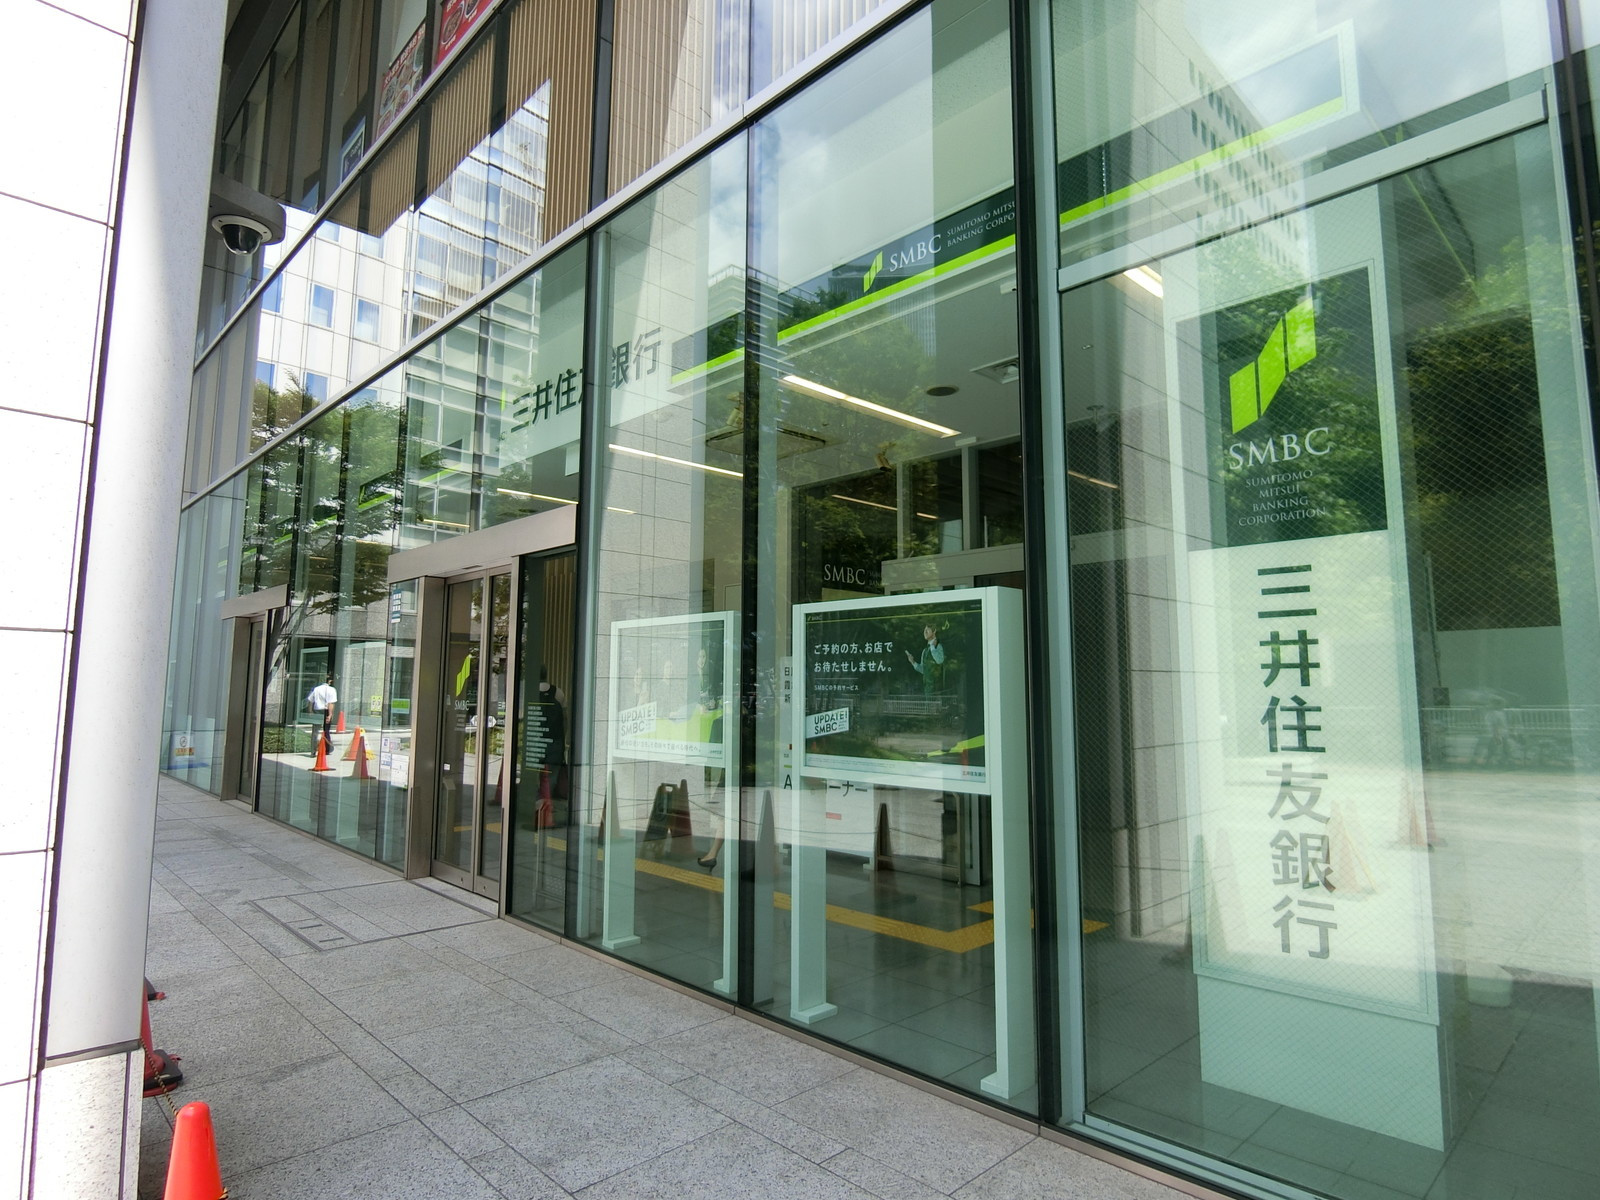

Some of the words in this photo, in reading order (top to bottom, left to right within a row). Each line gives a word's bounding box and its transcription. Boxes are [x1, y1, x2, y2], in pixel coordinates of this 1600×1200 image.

[947, 212, 991, 237] SUMITOMO
[947, 225, 984, 247] BANKING
[889, 234, 942, 272] SMBC
[1228, 427, 1331, 470] SMBC
[1245, 469, 1313, 488] SUMITOMO
[1259, 484, 1300, 498] MITSUI
[1252, 496, 1309, 512] BANKING
[1238, 507, 1326, 527] CORPORATION
[823, 563, 866, 585] SMBC
[814, 641, 893, 655] ご予約の方、お店で
[814, 660, 892, 673] お待たせしません。
[621, 707, 656, 724] UPDATE!
[814, 710, 848, 725] UPDATE!
[620, 721, 645, 737] SMBC
[814, 722, 838, 735] SMBC
[1257, 564, 1338, 960] 三井住友銀行
